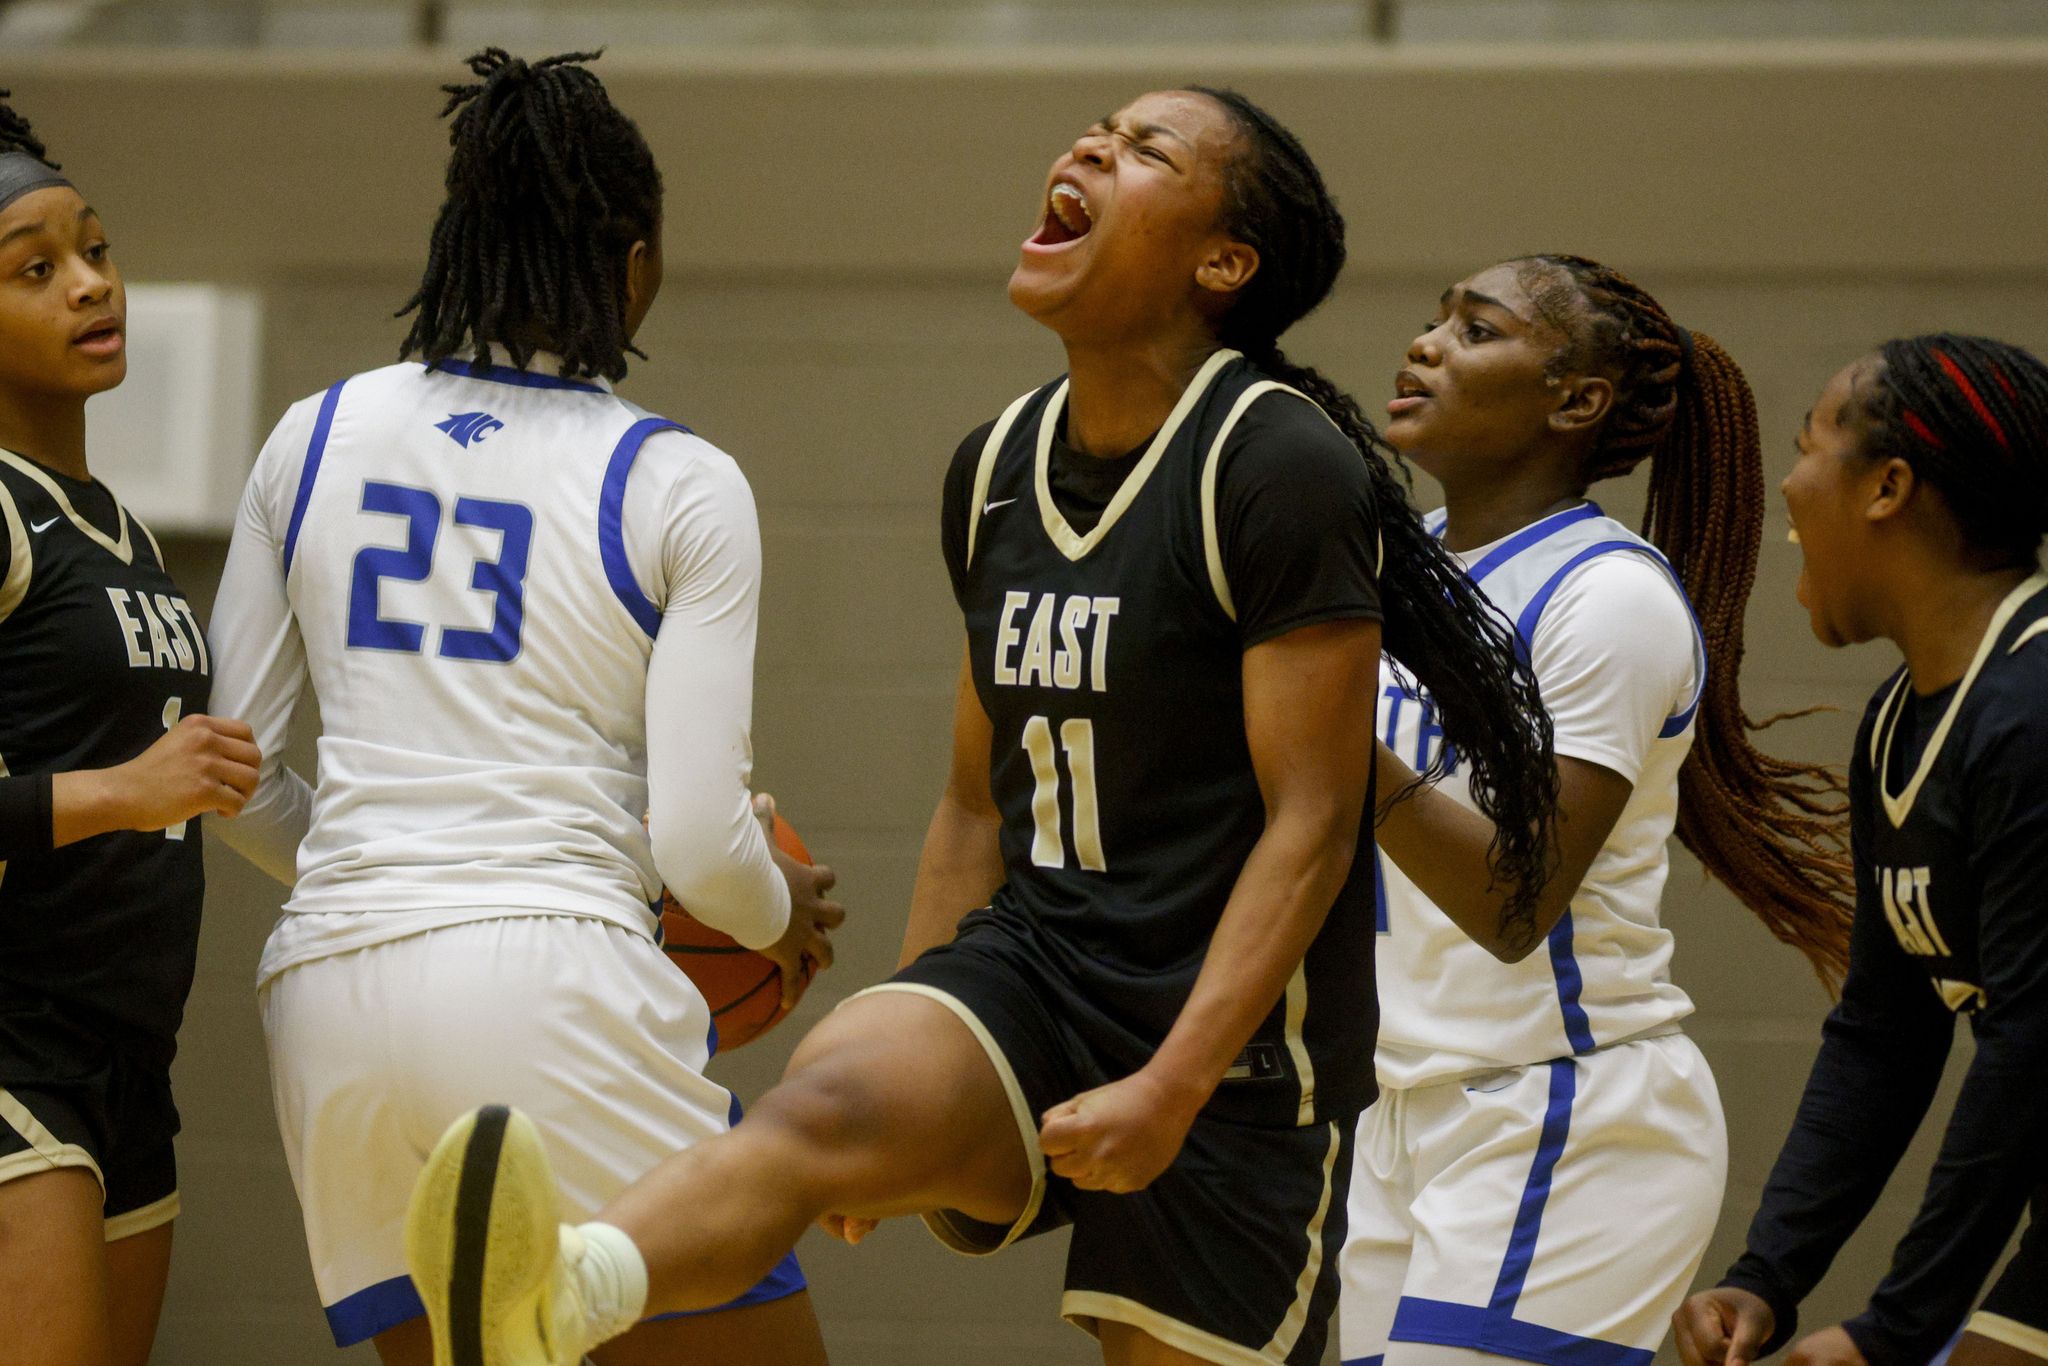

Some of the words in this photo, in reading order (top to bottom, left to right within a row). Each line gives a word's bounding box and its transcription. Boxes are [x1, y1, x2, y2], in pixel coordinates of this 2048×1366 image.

[345, 478, 536, 665] 23
[106, 587, 208, 676] EAST
[995, 591, 1120, 692] EAST
[1021, 715, 1107, 872] 11
[1875, 865, 1952, 957] AST
